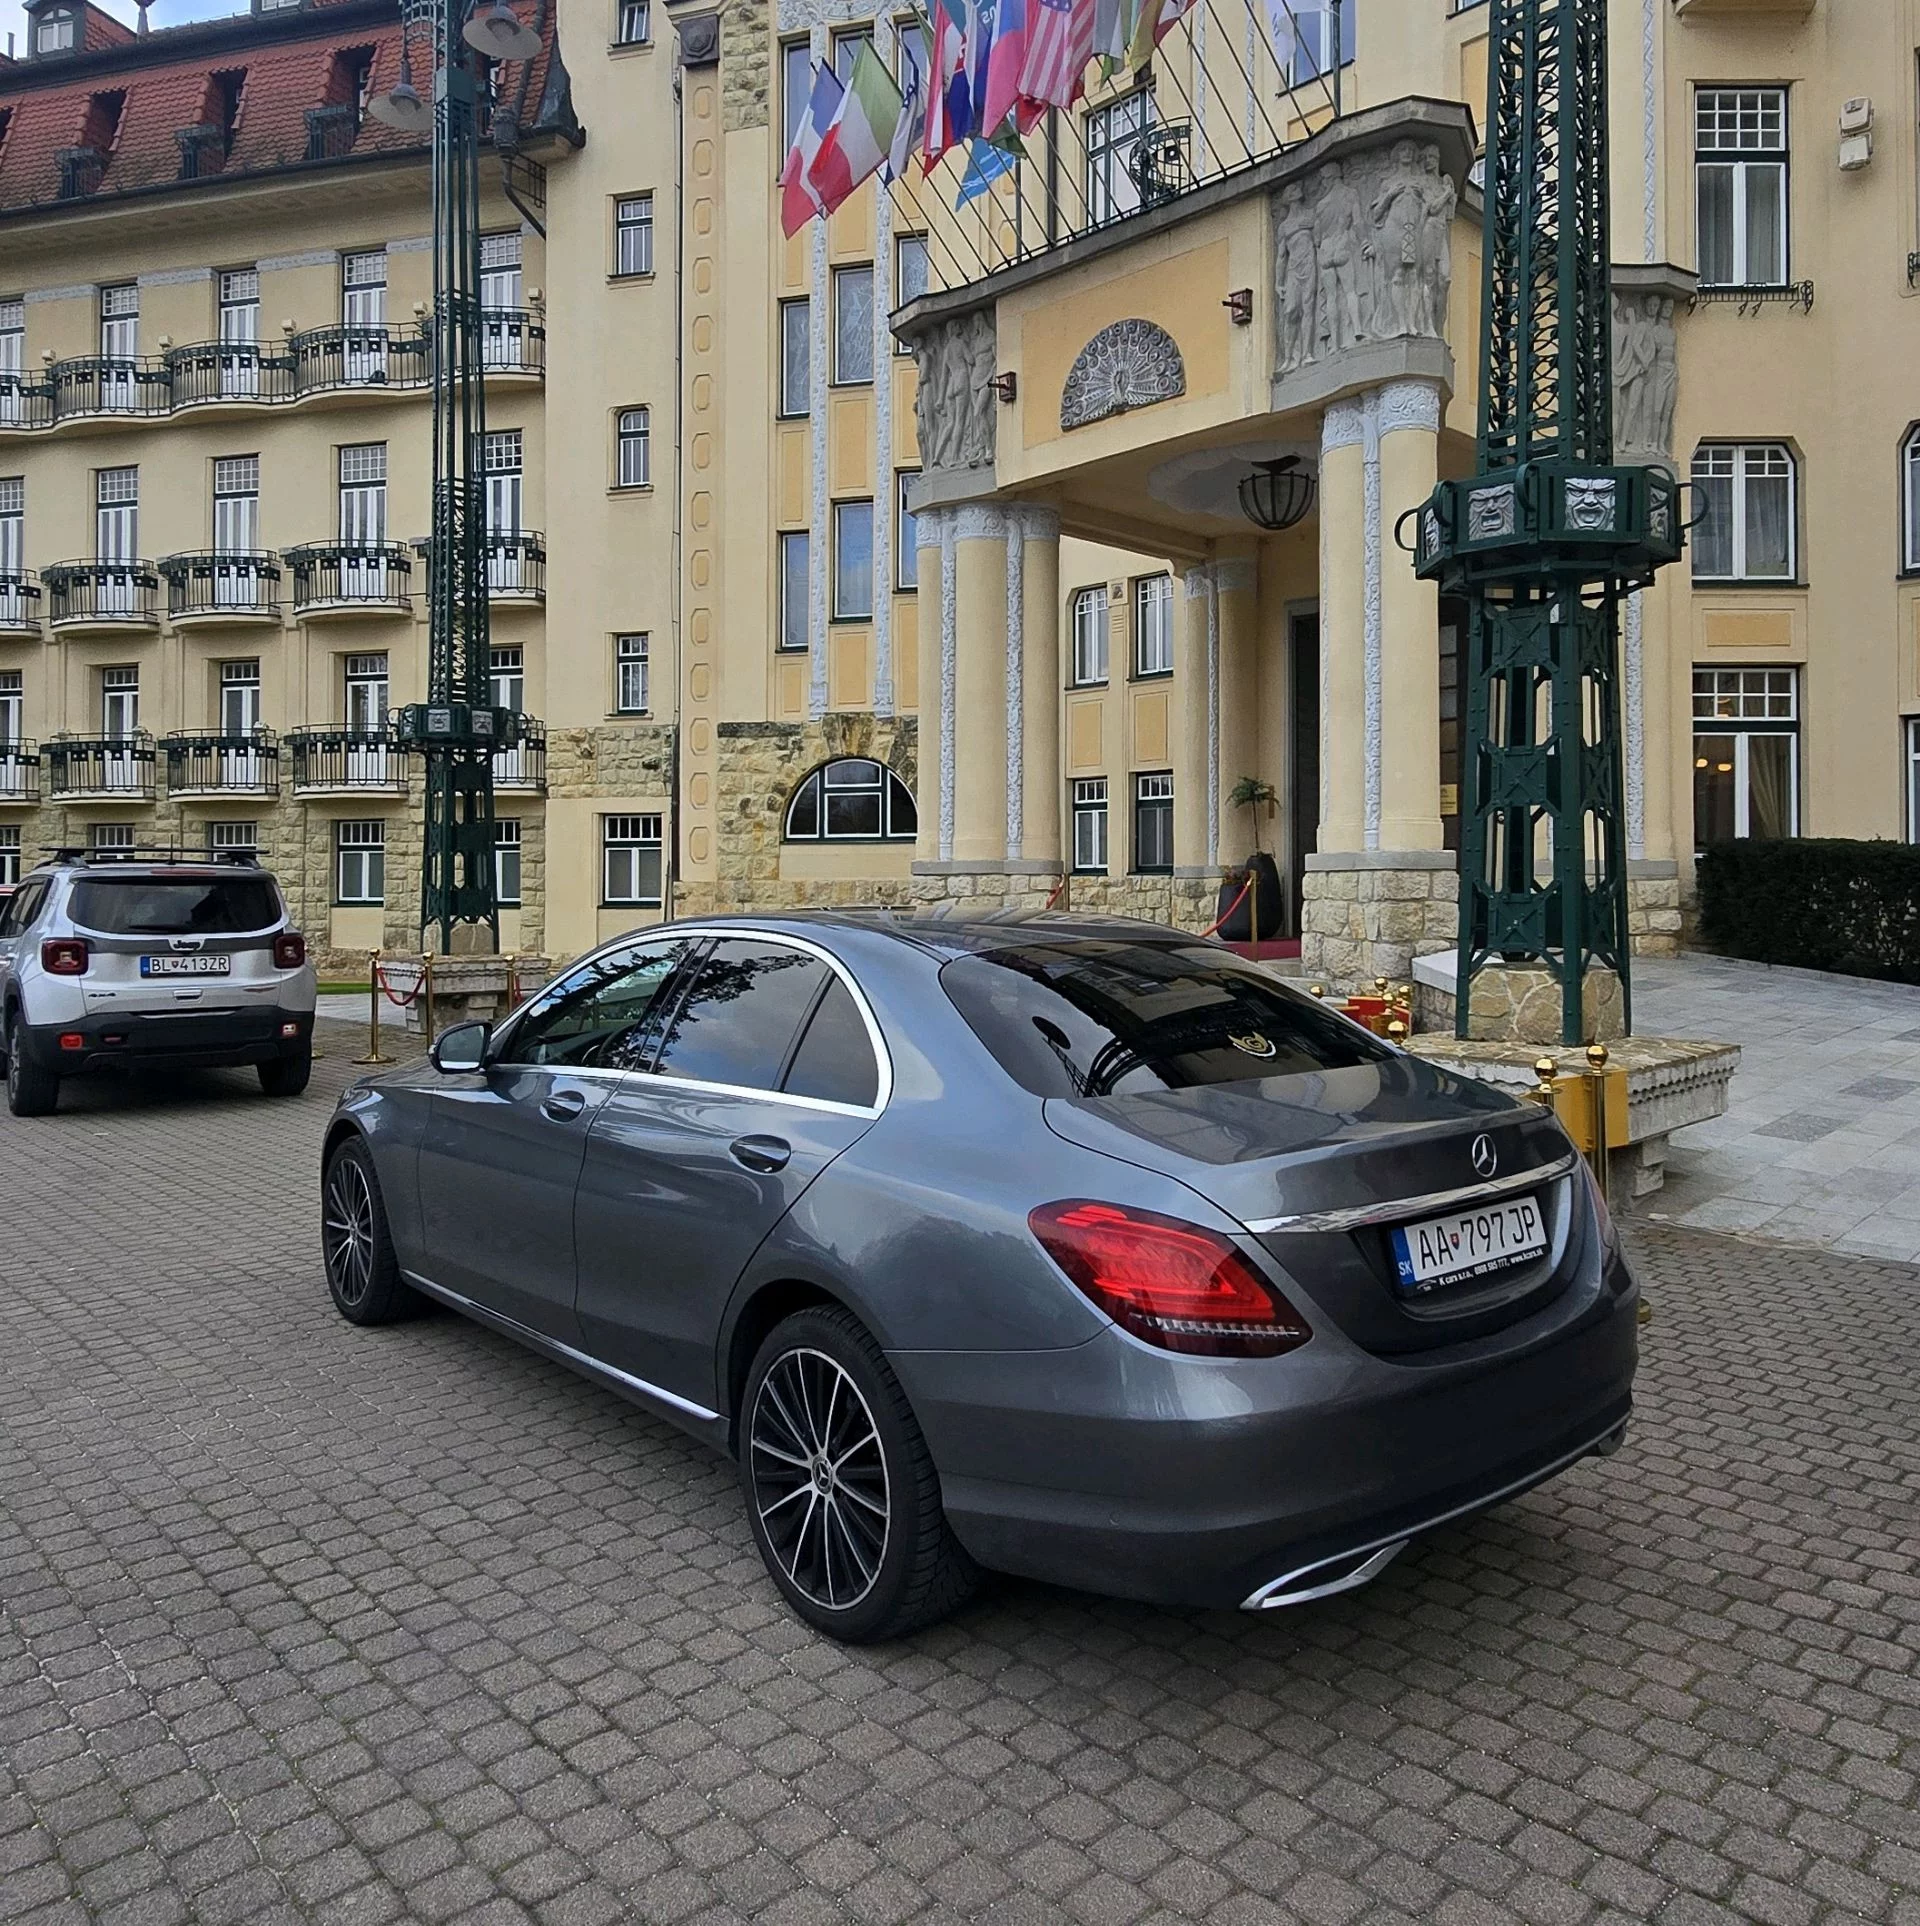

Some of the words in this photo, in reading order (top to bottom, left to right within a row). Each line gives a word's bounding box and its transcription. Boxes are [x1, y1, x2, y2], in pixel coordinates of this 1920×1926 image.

[151, 958, 171, 972] BL
[180, 957, 227, 971] 413ZR
[1419, 1225, 1454, 1270] AA
[1398, 1260, 1412, 1276] SK
